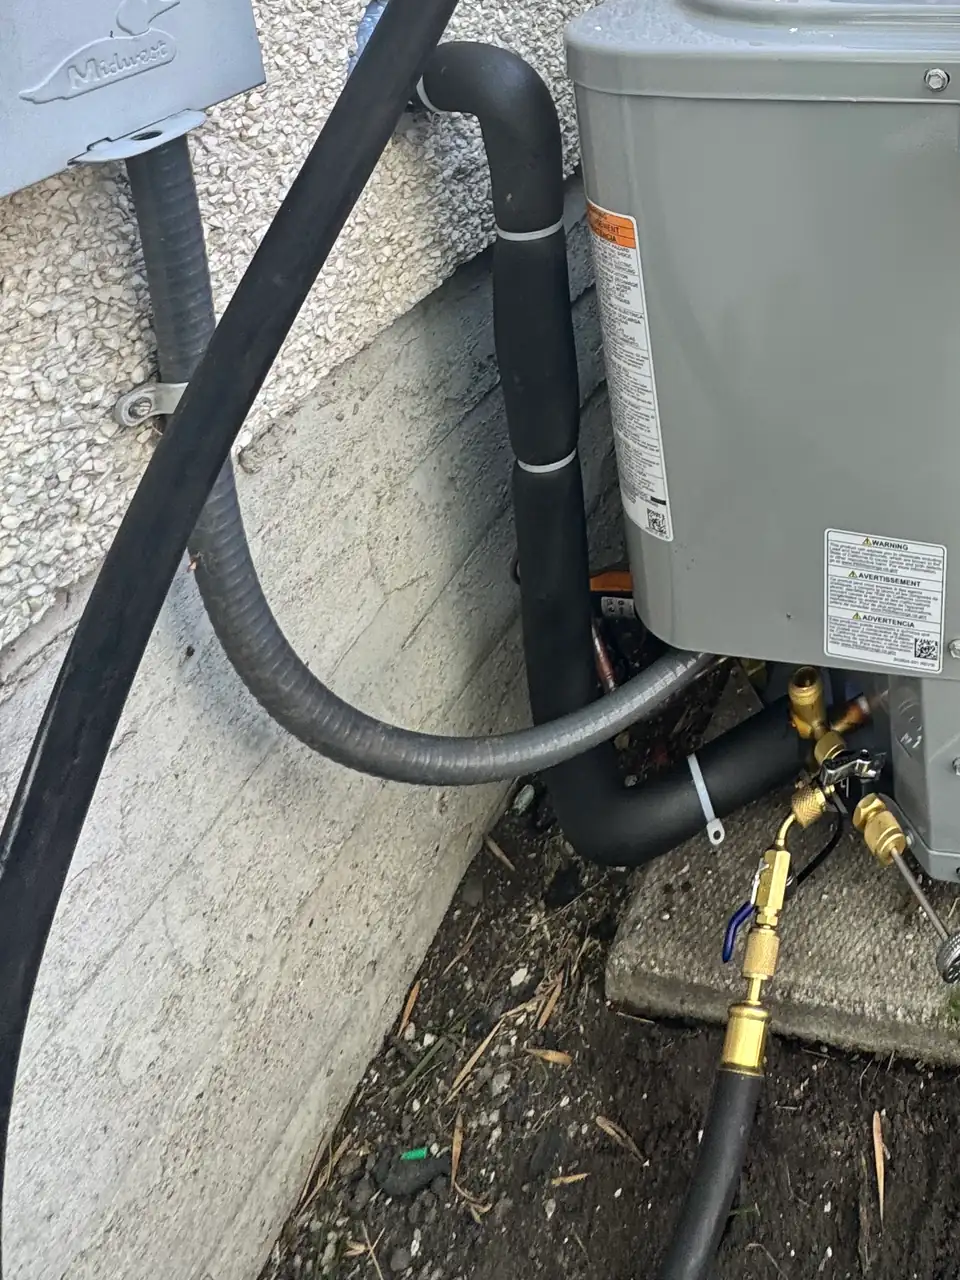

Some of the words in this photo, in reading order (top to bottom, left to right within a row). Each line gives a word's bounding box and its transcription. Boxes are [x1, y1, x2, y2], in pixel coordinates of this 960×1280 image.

[67, 40, 168, 90] Midwest
[872, 539, 909, 551] WARNING
[858, 572, 921, 587] AVERTISSEMENT
[862, 614, 915, 628] ADVERTENCIA
